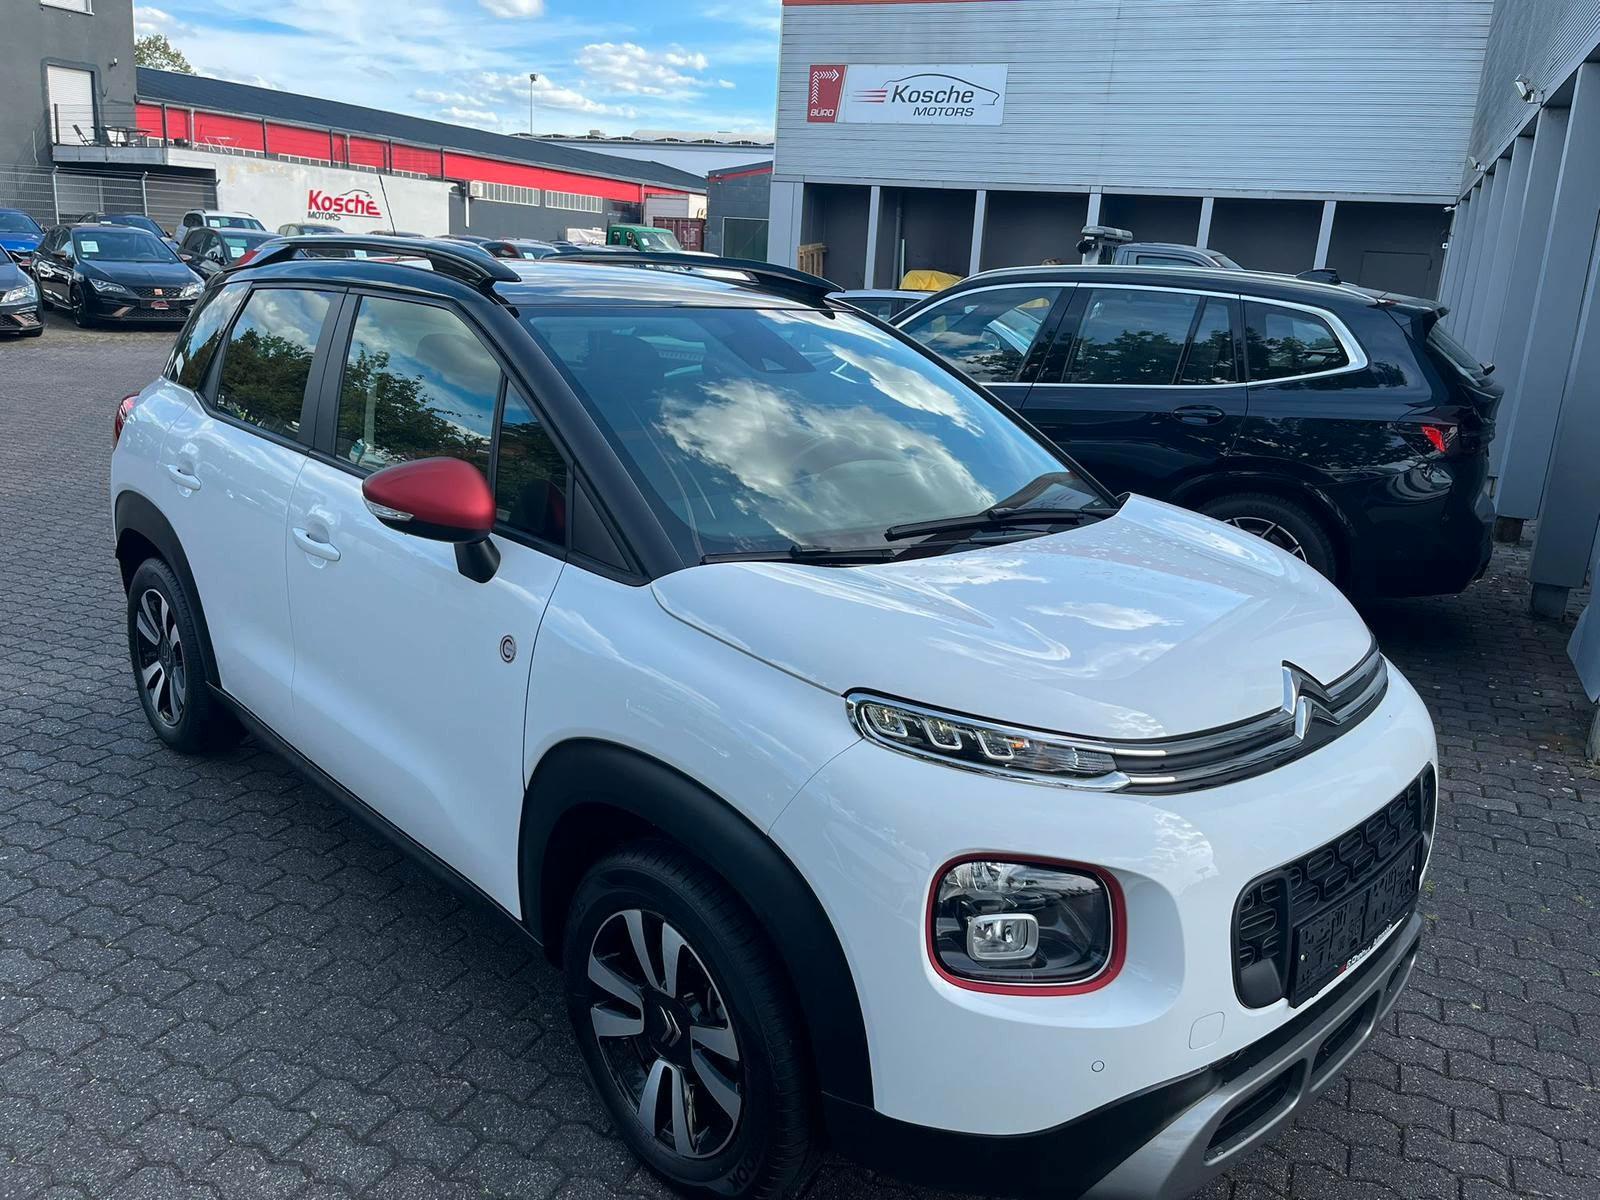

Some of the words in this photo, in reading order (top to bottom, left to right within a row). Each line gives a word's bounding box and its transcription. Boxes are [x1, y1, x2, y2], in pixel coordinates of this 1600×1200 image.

[891, 84, 974, 104] Kosche
[913, 106, 975, 117] MOTORS
[308, 190, 381, 215] Kosche
[307, 211, 341, 221] MOTORS
